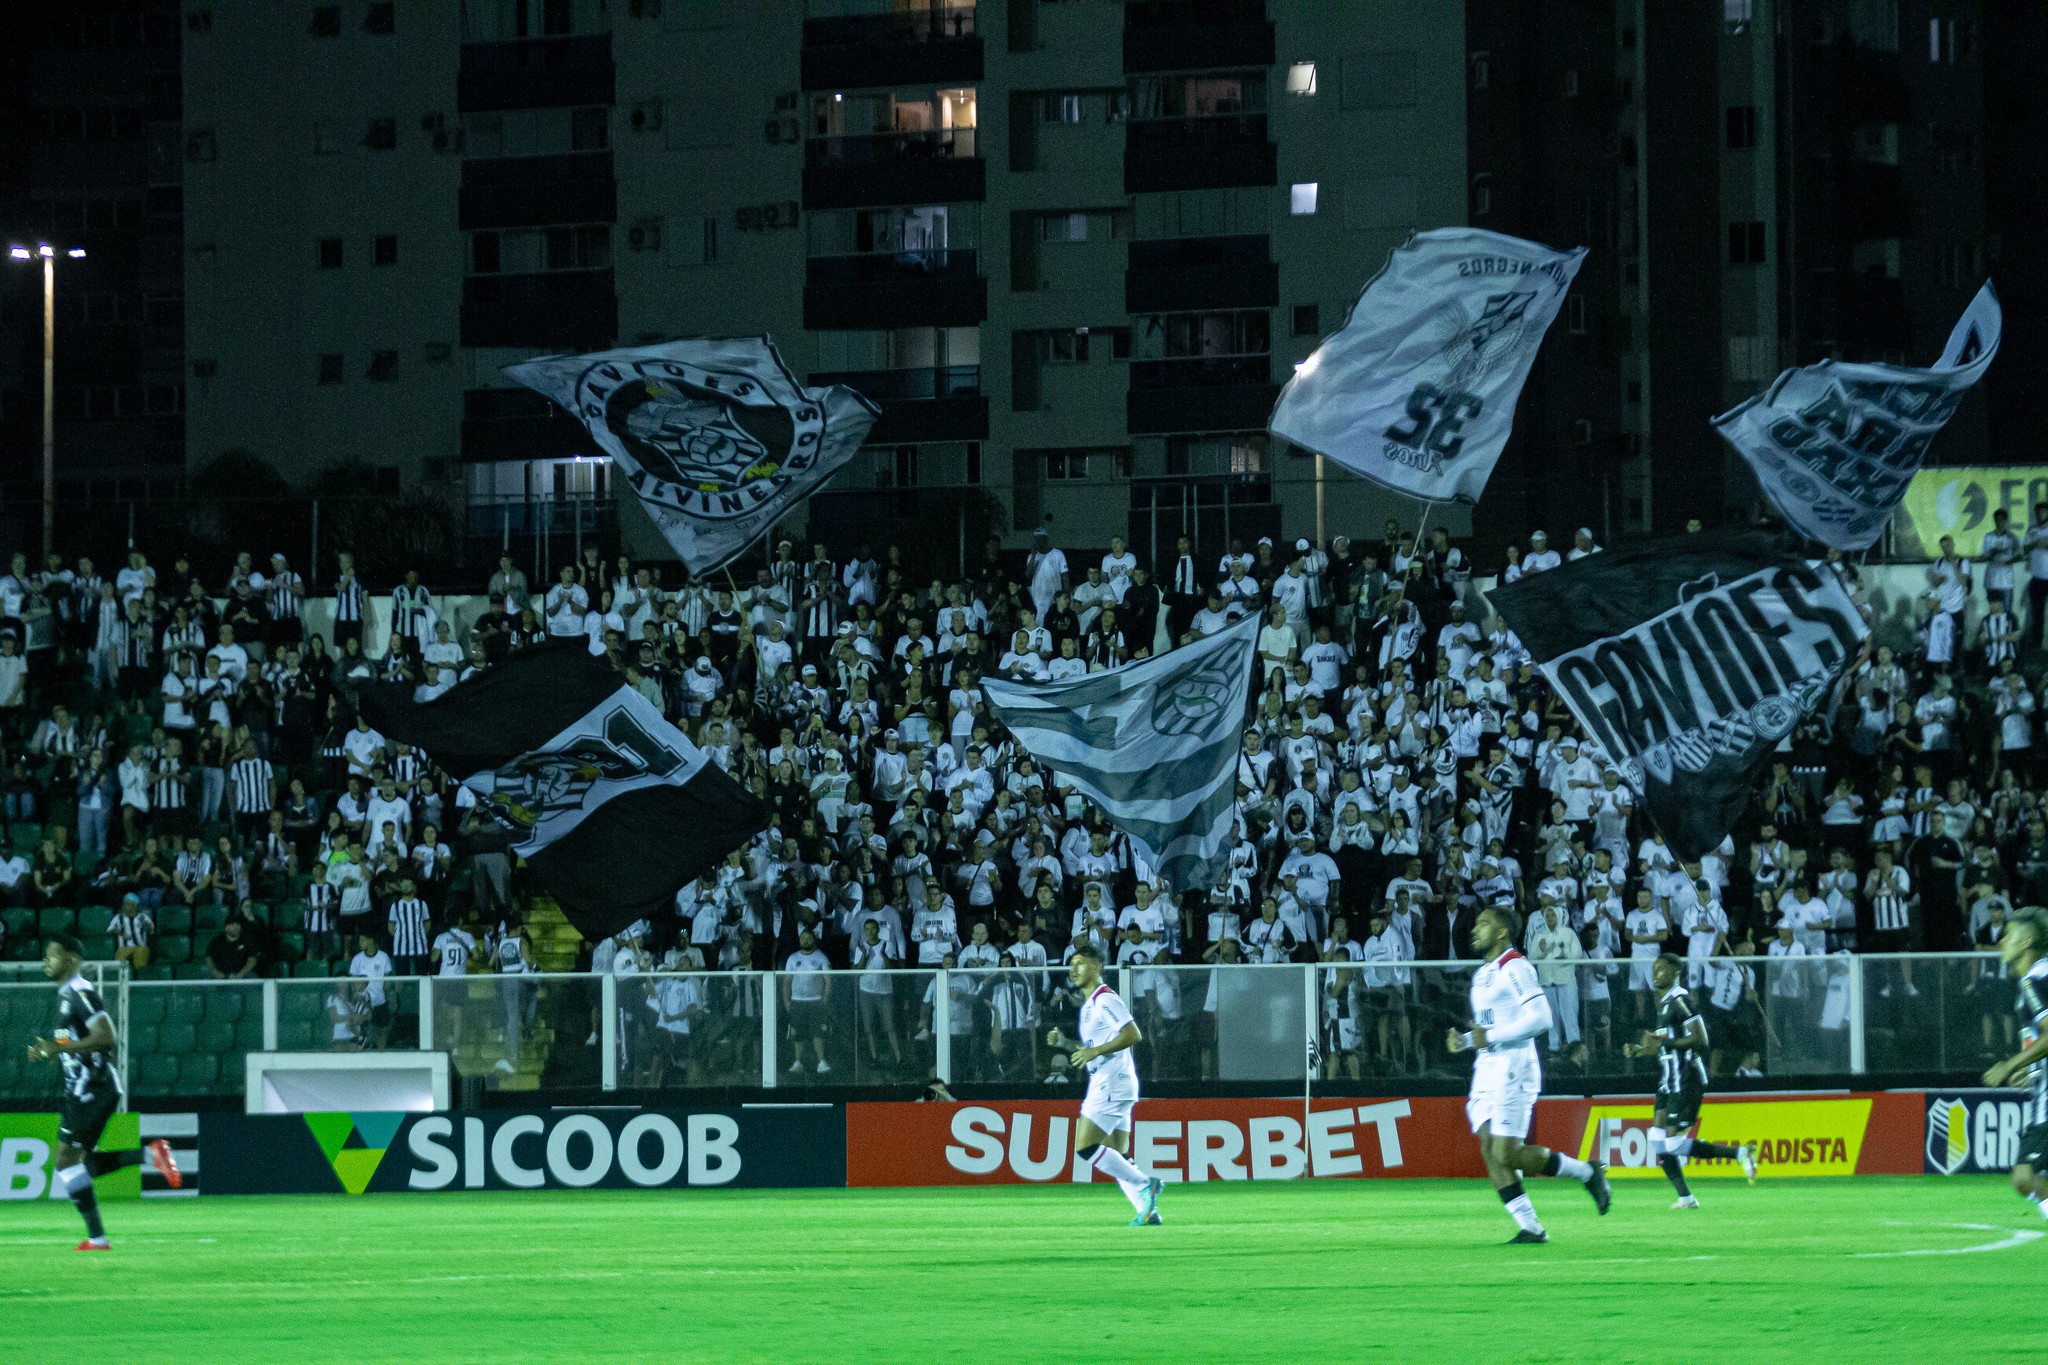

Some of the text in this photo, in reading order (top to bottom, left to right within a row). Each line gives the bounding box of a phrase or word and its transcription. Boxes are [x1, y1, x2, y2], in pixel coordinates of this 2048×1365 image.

[628, 407, 820, 514] ALVINEGROS
[1556, 566, 1866, 757] GAVIÕES
[407, 1112, 743, 1191] SICOOB
[1974, 1099, 2033, 1171] GR
